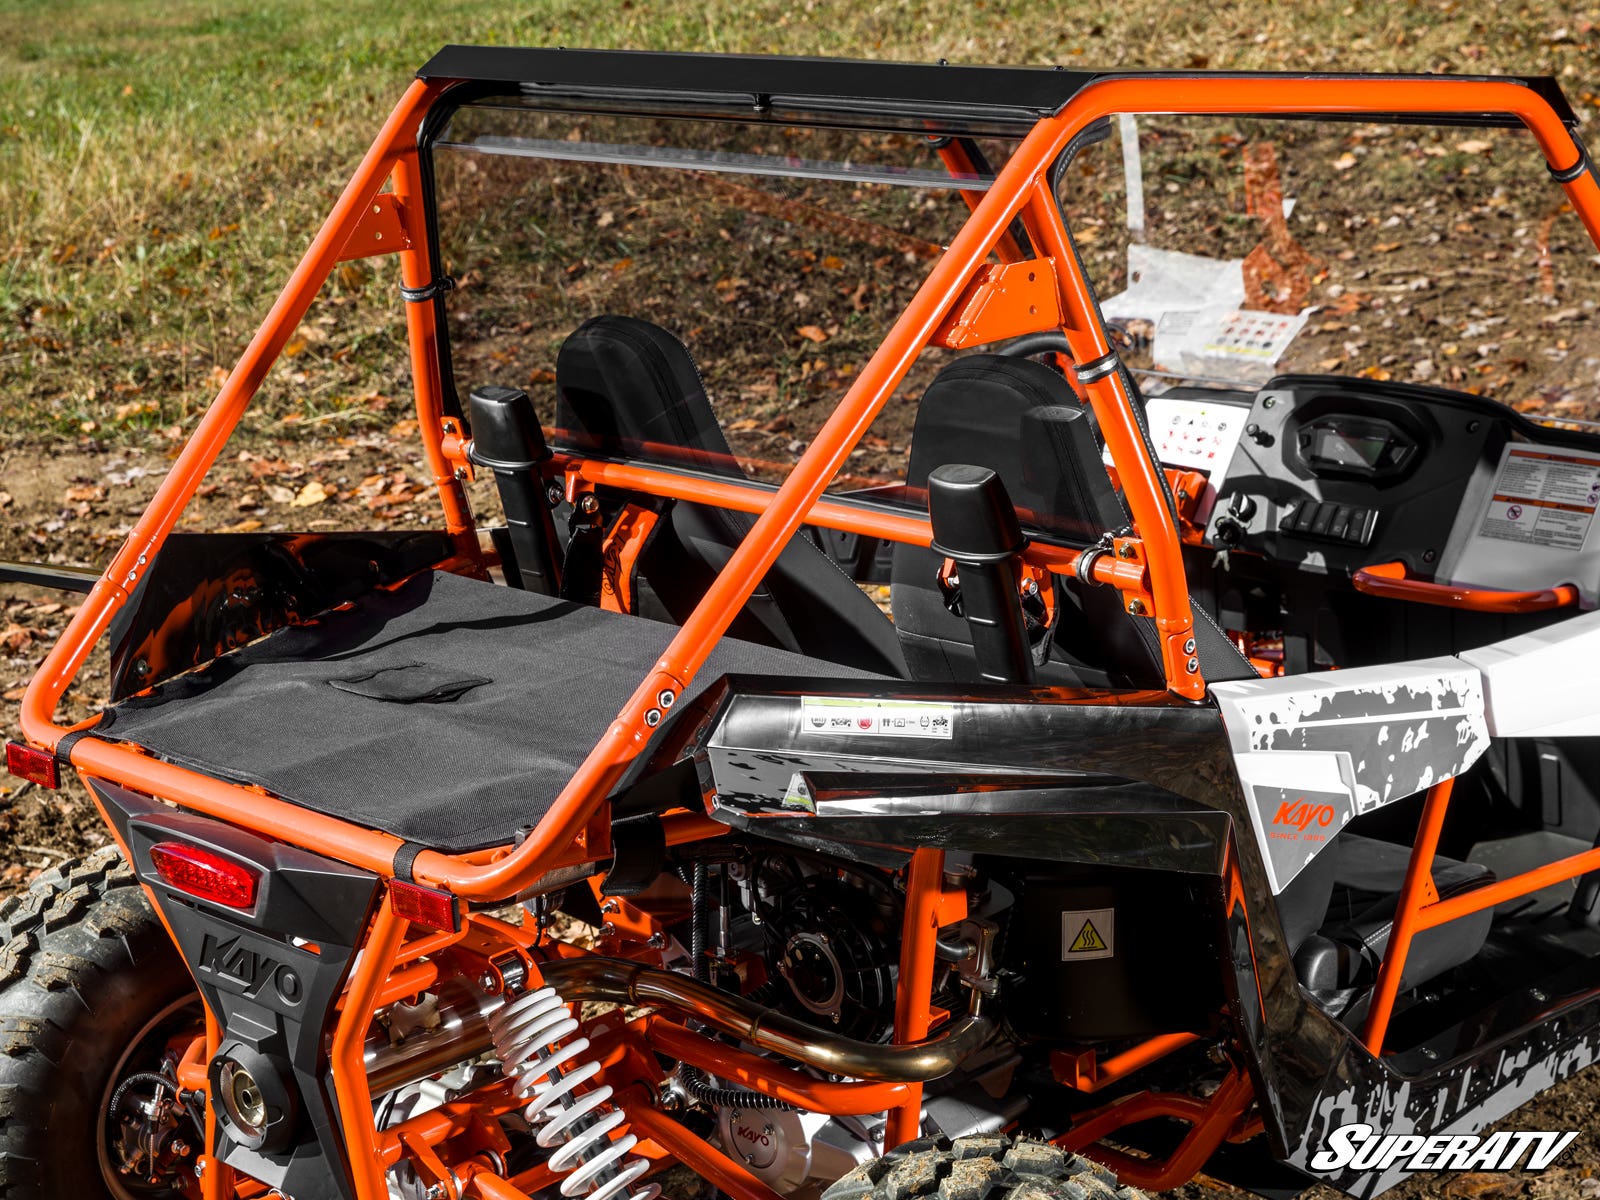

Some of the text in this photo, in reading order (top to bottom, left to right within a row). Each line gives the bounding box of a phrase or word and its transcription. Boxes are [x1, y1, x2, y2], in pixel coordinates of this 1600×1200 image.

[1272, 796, 1335, 832] KAYO
[1270, 831, 1298, 841] SINCE
[199, 933, 304, 1007] KAYO
[737, 1127, 770, 1147] KAYO
